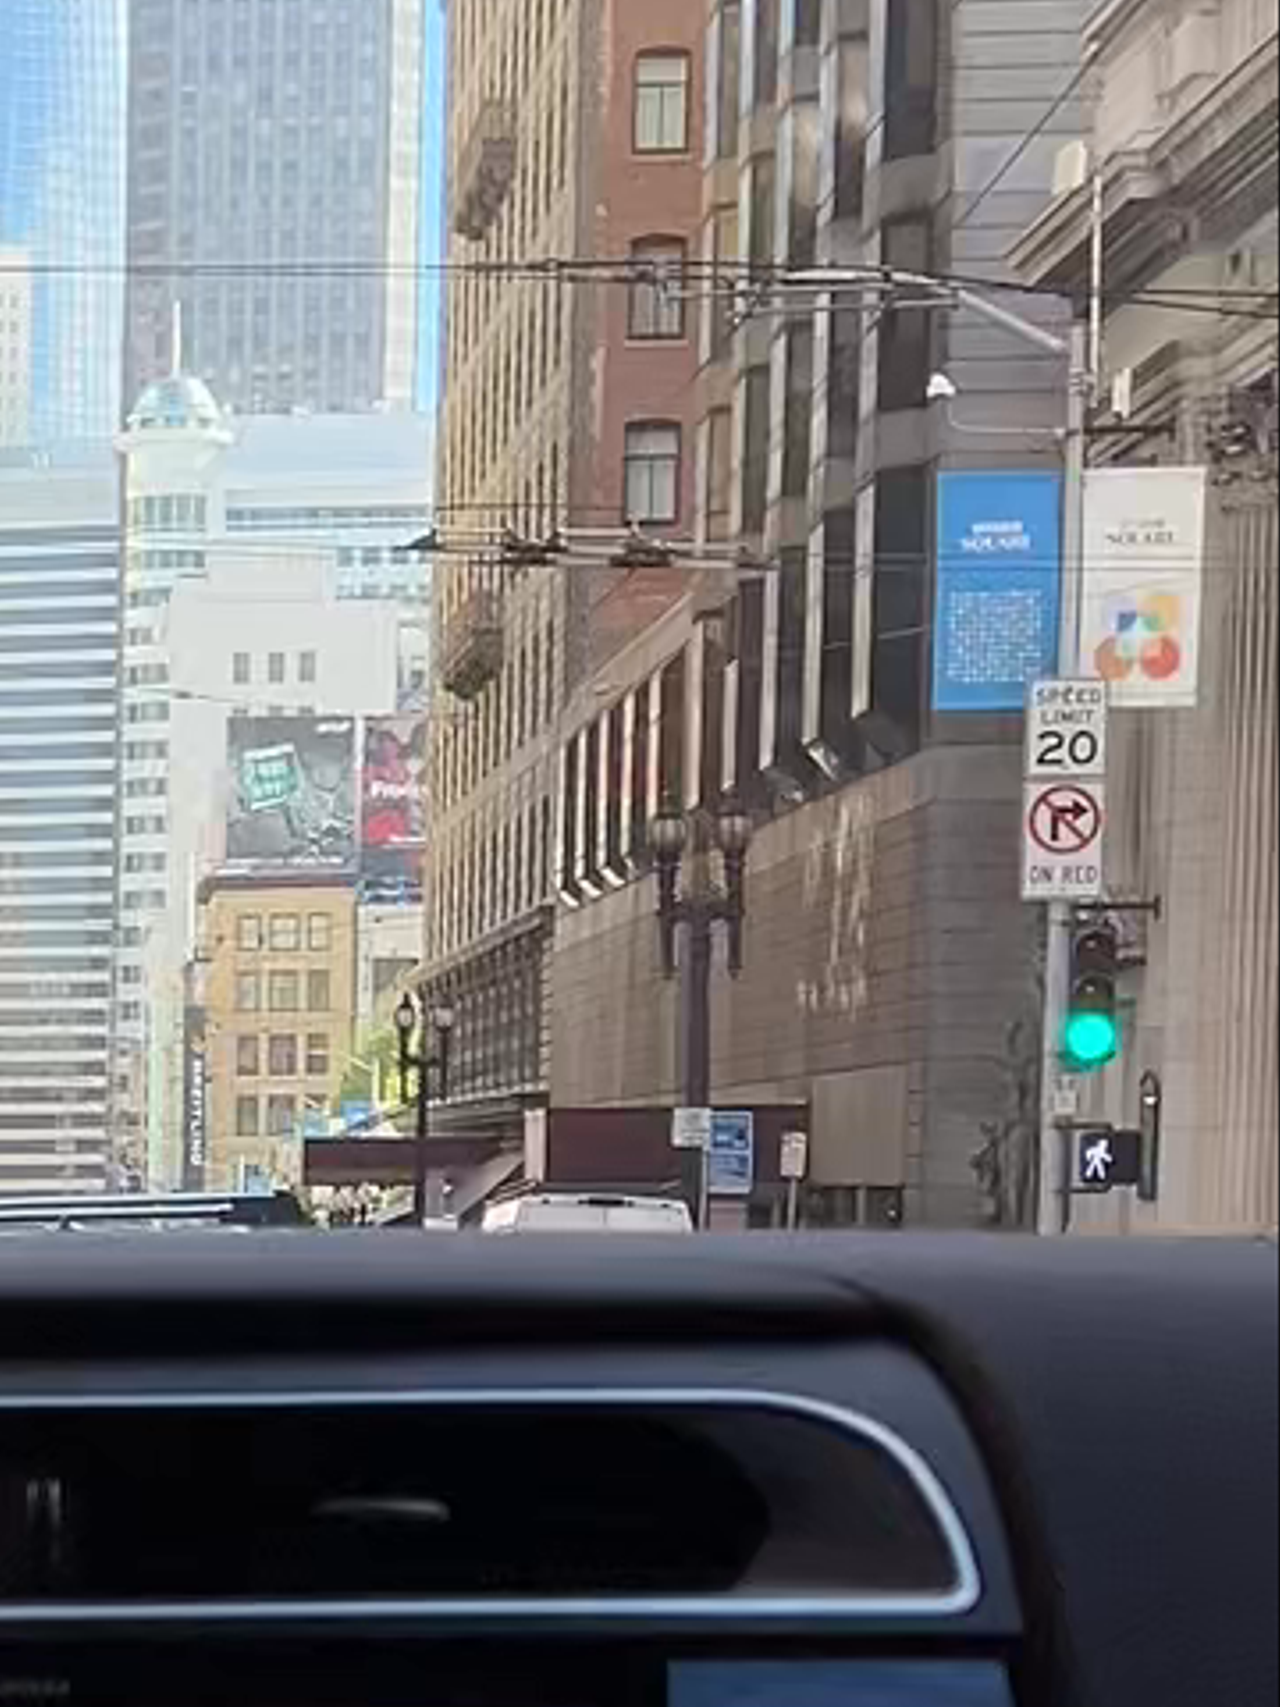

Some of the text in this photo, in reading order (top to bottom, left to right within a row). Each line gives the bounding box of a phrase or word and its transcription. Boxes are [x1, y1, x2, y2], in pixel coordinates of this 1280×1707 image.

[1037, 687, 1101, 705] SPEED
[1042, 709, 1093, 724] LIMIT
[1036, 730, 1098, 765] 20
[1030, 865, 1097, 884] ON RED
